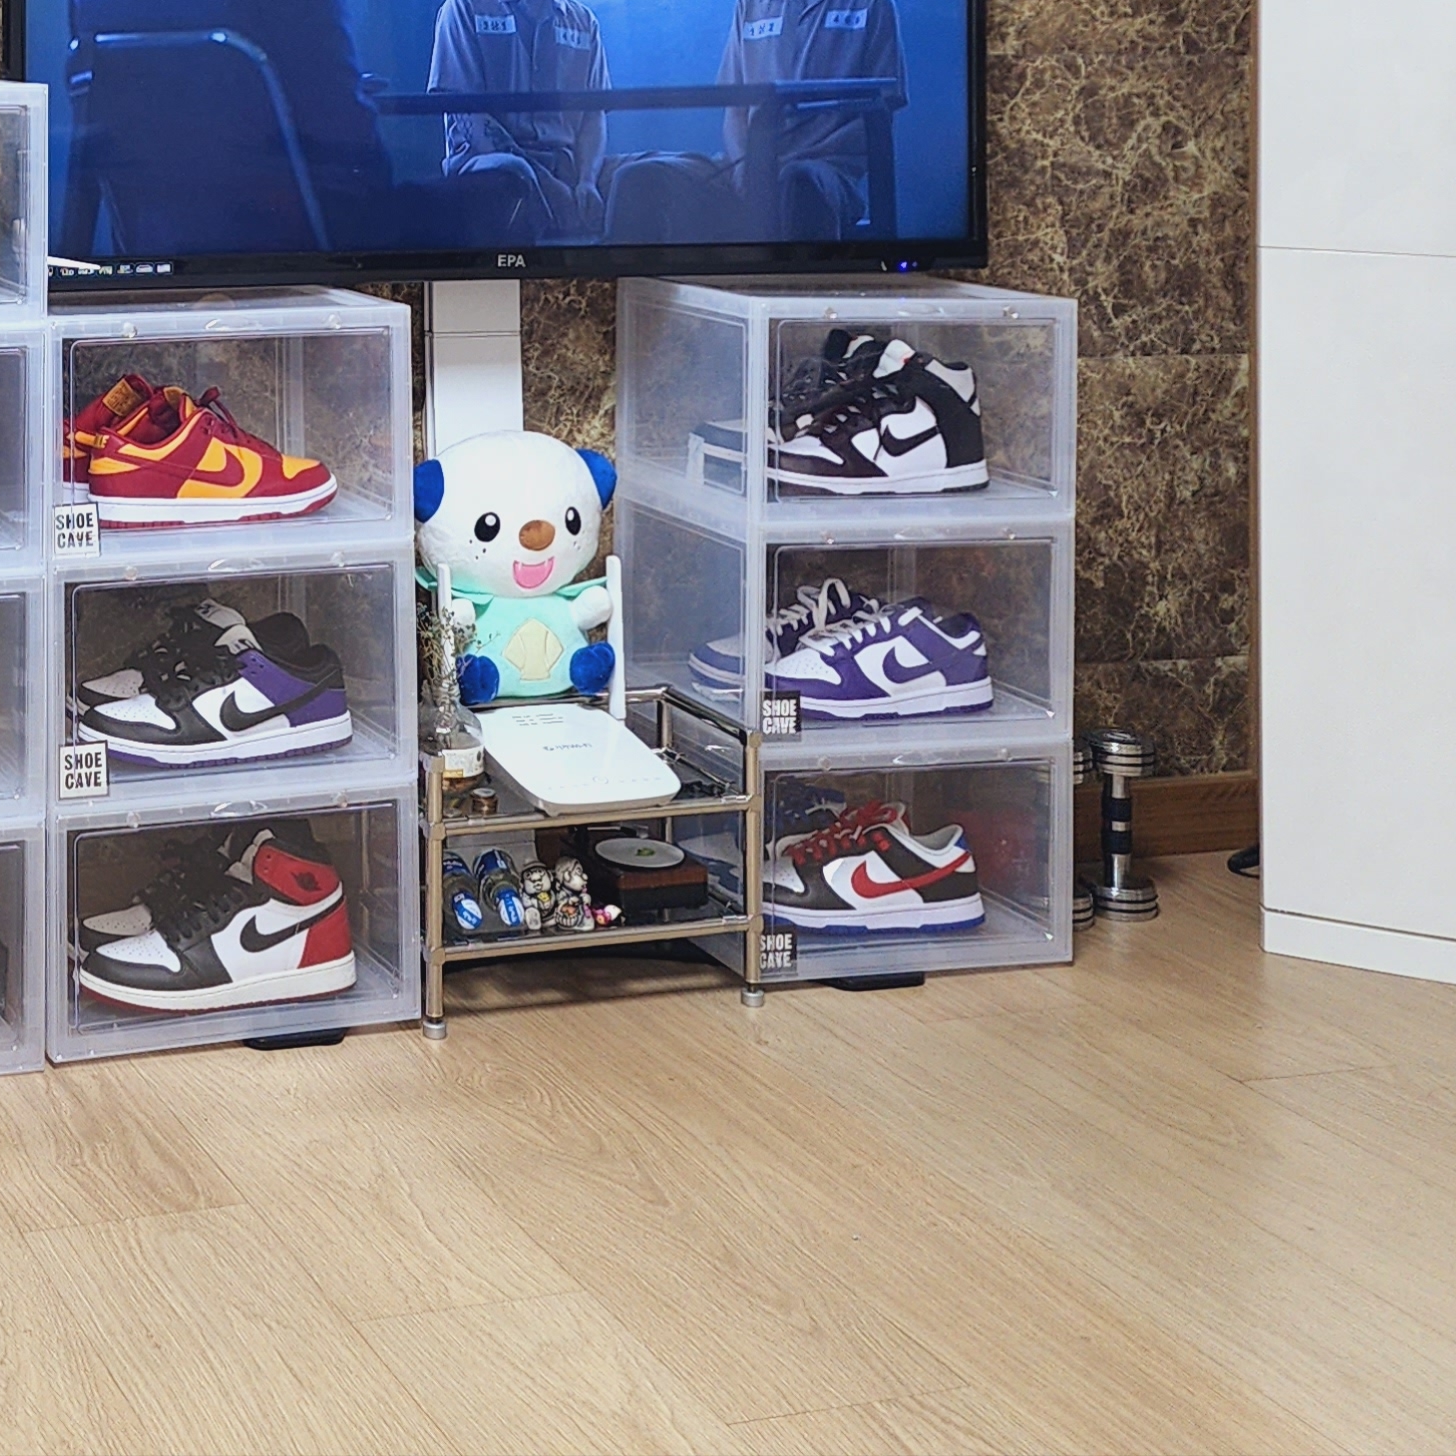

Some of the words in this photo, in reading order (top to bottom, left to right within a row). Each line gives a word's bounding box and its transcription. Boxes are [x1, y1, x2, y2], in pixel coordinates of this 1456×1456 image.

[497, 254, 526, 268] EPA
[55, 512, 94, 531] SHOE
[57, 531, 94, 549] CAVE
[762, 698, 797, 717] SHOE
[762, 716, 797, 735] CAVE
[64, 751, 103, 771] SHOE
[64, 771, 102, 790] CAVE
[759, 933, 793, 952] SHOE
[759, 951, 792, 970] CAVE
